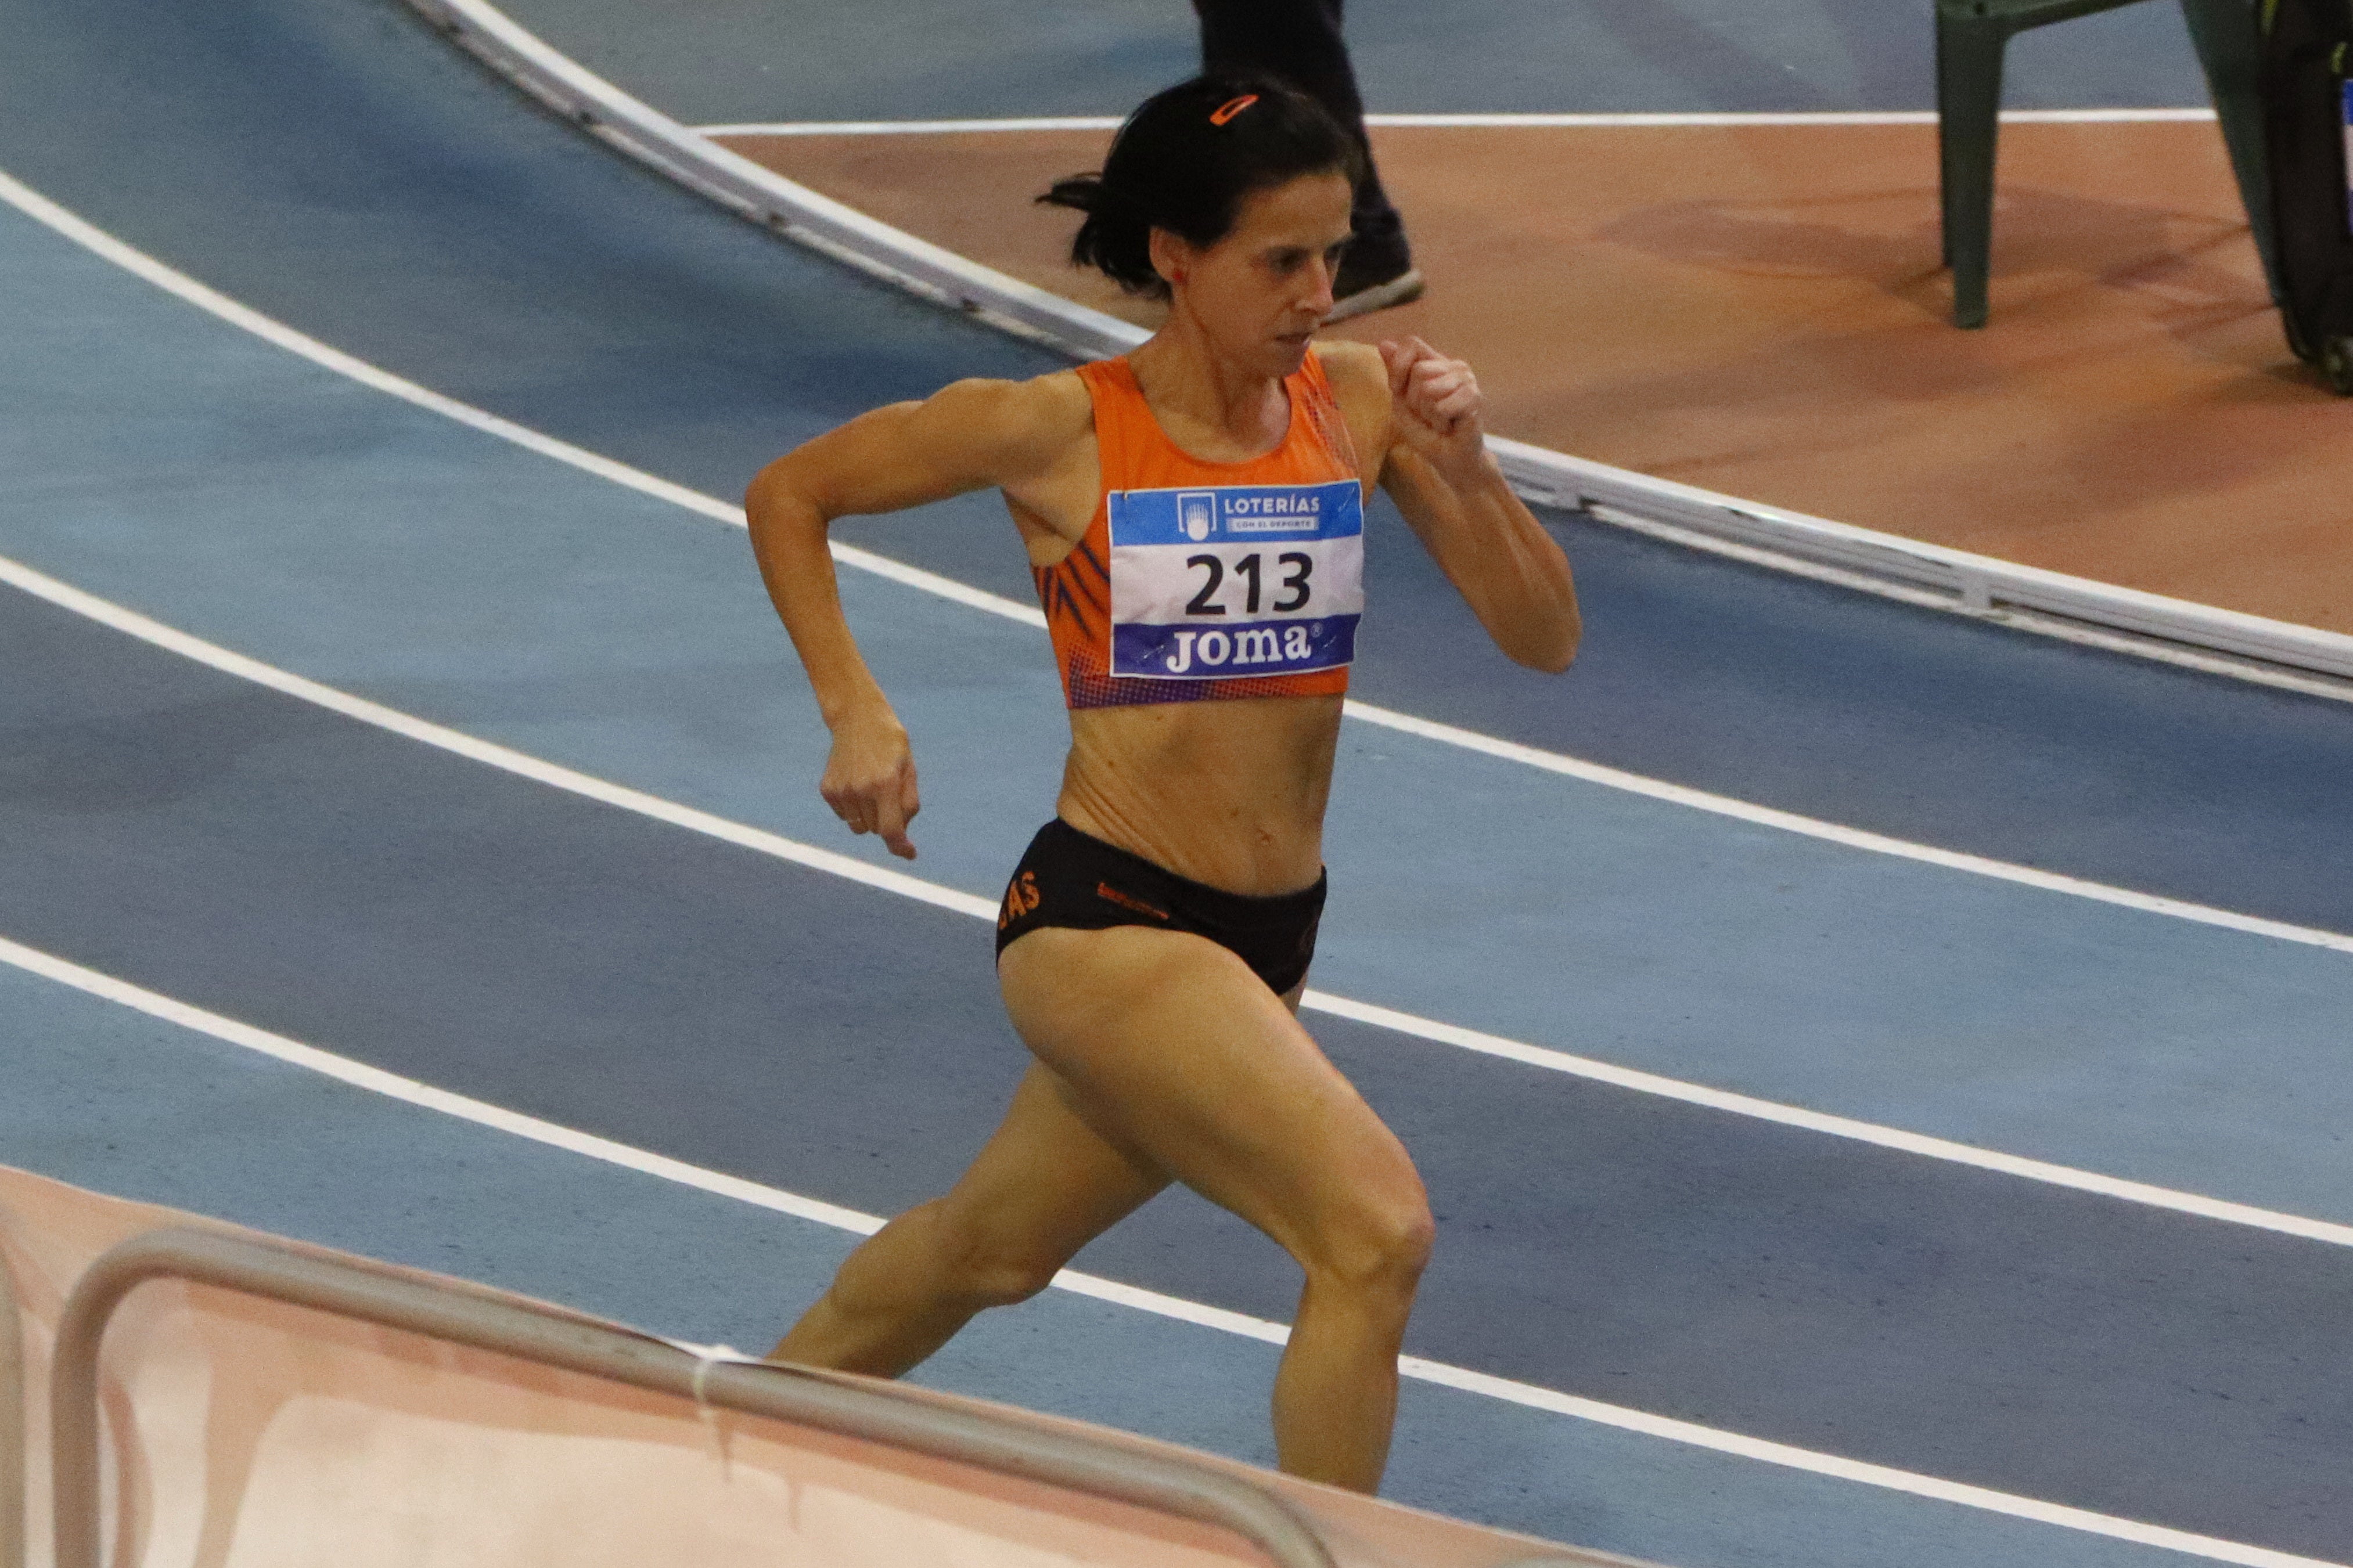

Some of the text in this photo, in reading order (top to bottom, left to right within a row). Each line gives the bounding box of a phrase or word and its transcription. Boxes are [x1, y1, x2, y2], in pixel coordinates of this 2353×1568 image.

[1224, 494, 1321, 514] LOTERÍAS
[1235, 521, 1255, 529] CON
[1269, 520, 1311, 528] DEPORTE
[1185, 551, 1313, 617] 213
